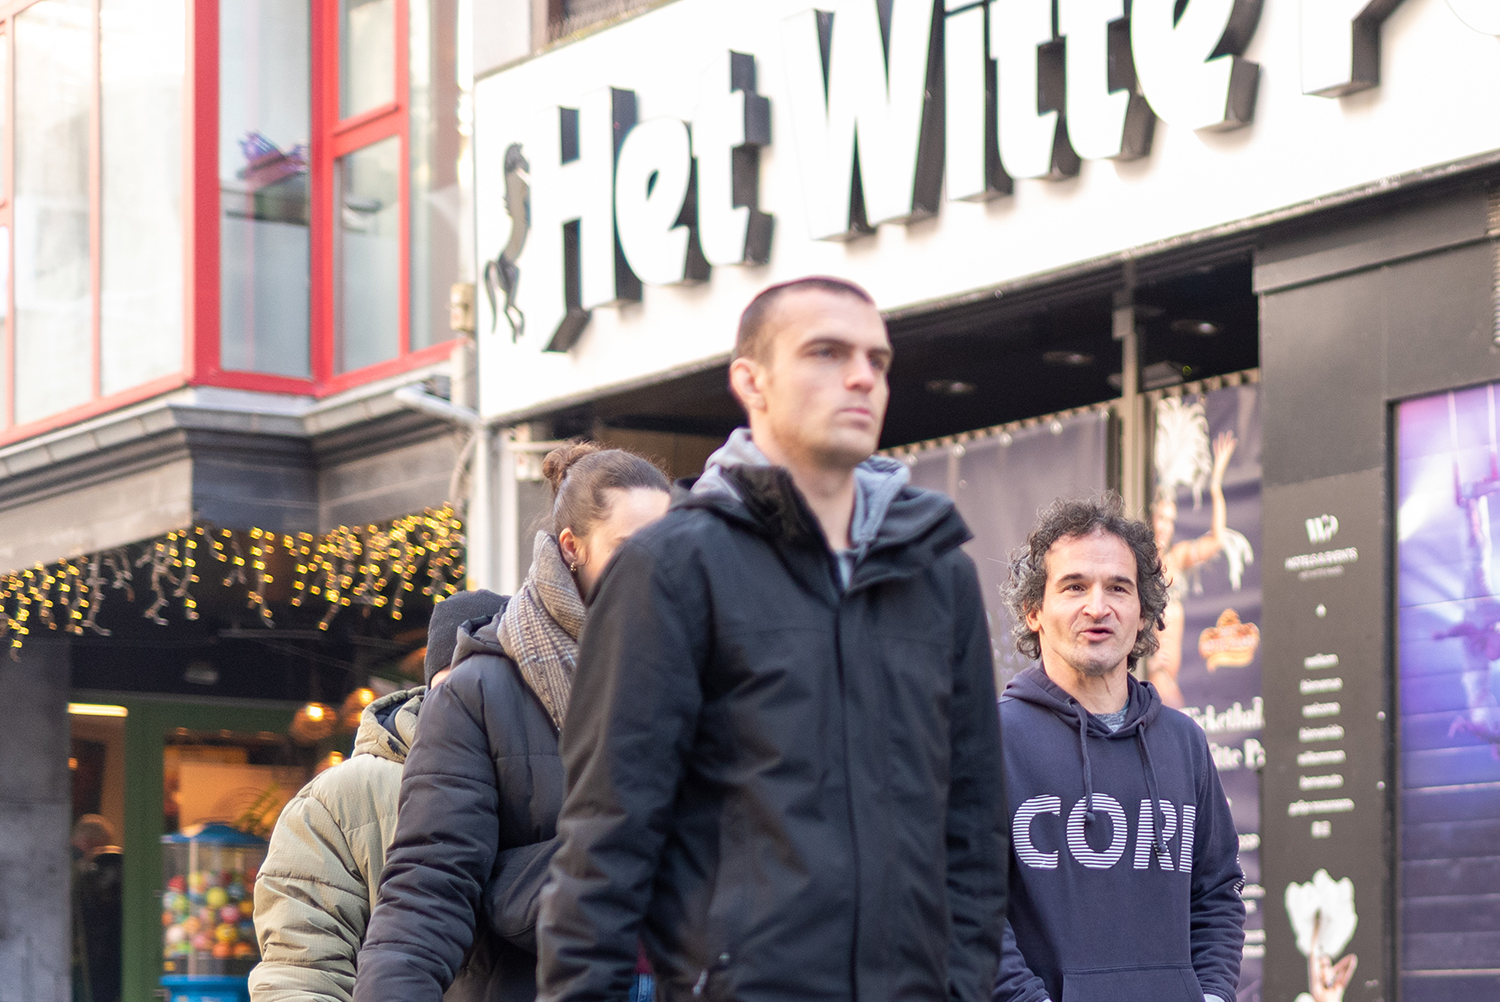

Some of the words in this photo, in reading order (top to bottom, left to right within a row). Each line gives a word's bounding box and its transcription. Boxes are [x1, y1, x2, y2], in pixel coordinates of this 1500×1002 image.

[537, 50, 773, 352] Het
[781, 0, 1262, 242] Witte
[1209, 742, 1243, 771] itte
